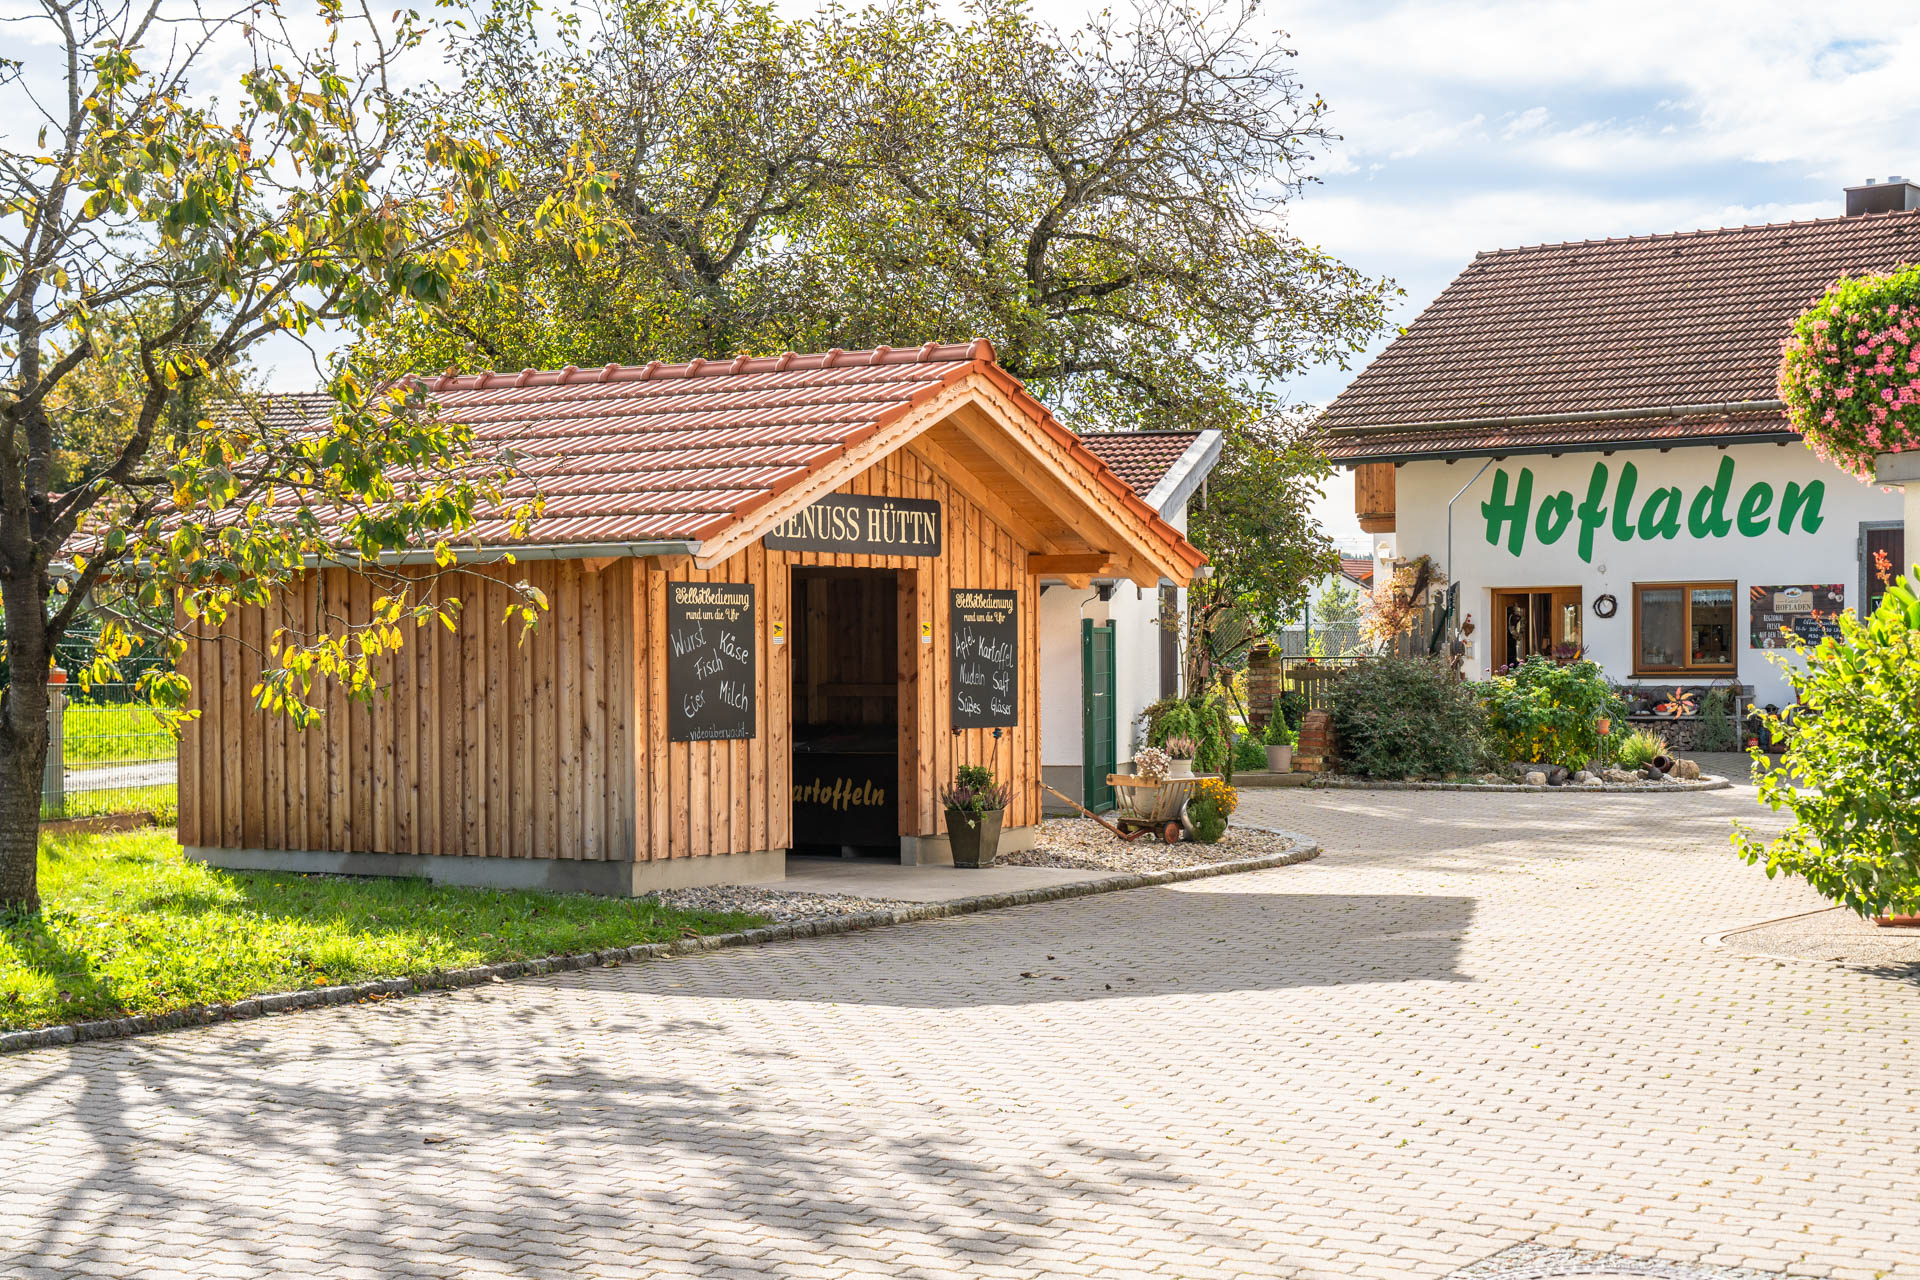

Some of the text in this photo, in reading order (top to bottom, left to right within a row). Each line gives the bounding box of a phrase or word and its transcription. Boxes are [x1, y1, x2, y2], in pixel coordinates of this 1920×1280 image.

[866, 502, 937, 545] HÜTTN
[1480, 454, 1826, 564] Hofladen
[675, 586, 750, 611] Selbstbedienung
[955, 592, 1014, 615] Selbstbedienung
[1775, 603, 1812, 611] HOFLADEN
[685, 608, 740, 623] rund um die Uhr
[963, 611, 976, 622] rund
[976, 614, 985, 622] um
[985, 611, 994, 622] die
[670, 620, 707, 657] Wurst
[719, 630, 749, 664] Käse
[978, 635, 1014, 671] Kartoffel
[694, 648, 724, 680] Fisch
[959, 662, 986, 687] Nudeln
[719, 680, 749, 713] Milch
[992, 670, 1011, 697] Saft
[683, 689, 706, 718] Eier
[792, 777, 885, 811] artoffeln
